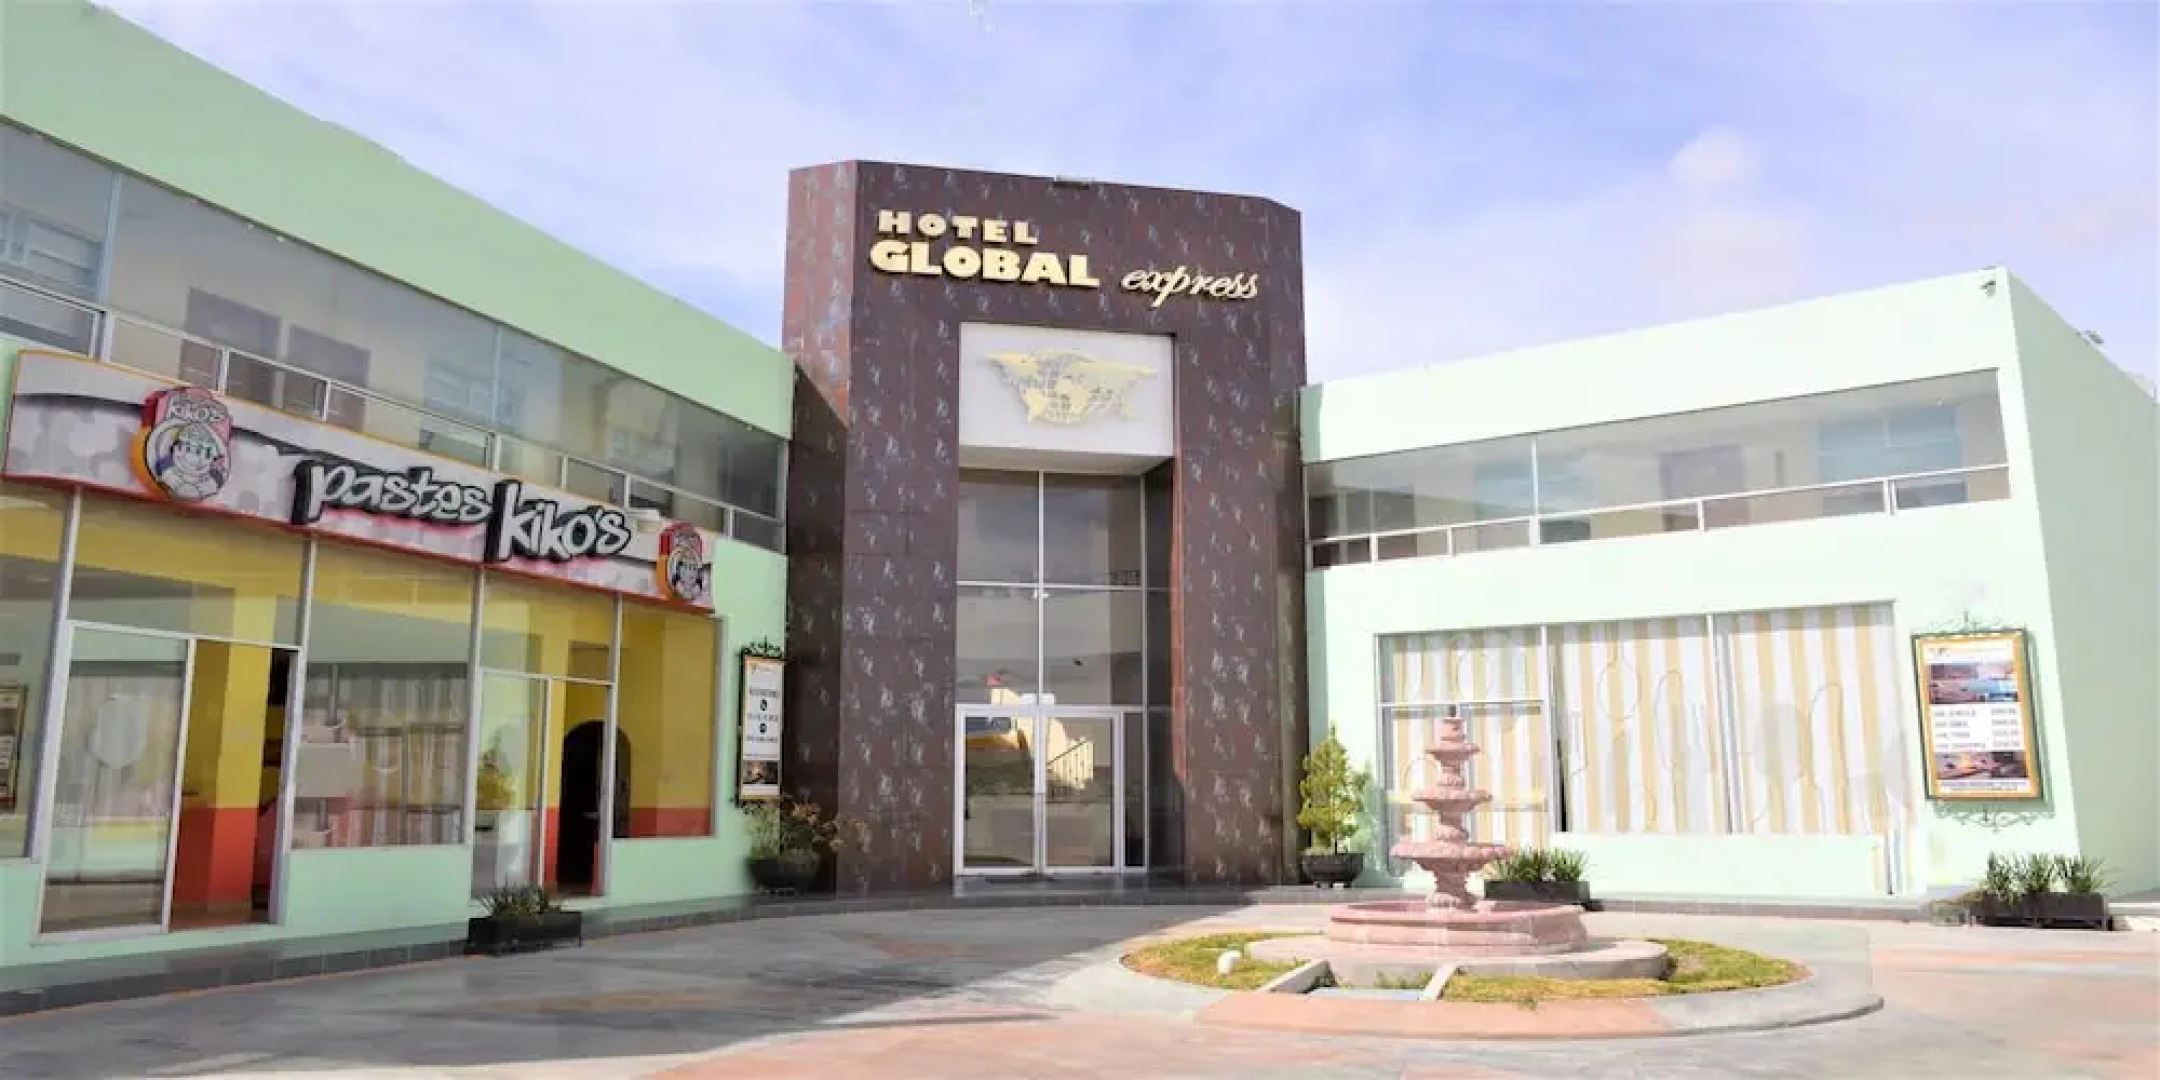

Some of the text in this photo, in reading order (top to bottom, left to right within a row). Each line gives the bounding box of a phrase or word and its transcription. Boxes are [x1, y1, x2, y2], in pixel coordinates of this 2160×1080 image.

[877, 209, 1038, 245] HOTEL
[869, 239, 1259, 308] GLOBAL express
[303, 462, 494, 524] pastes
